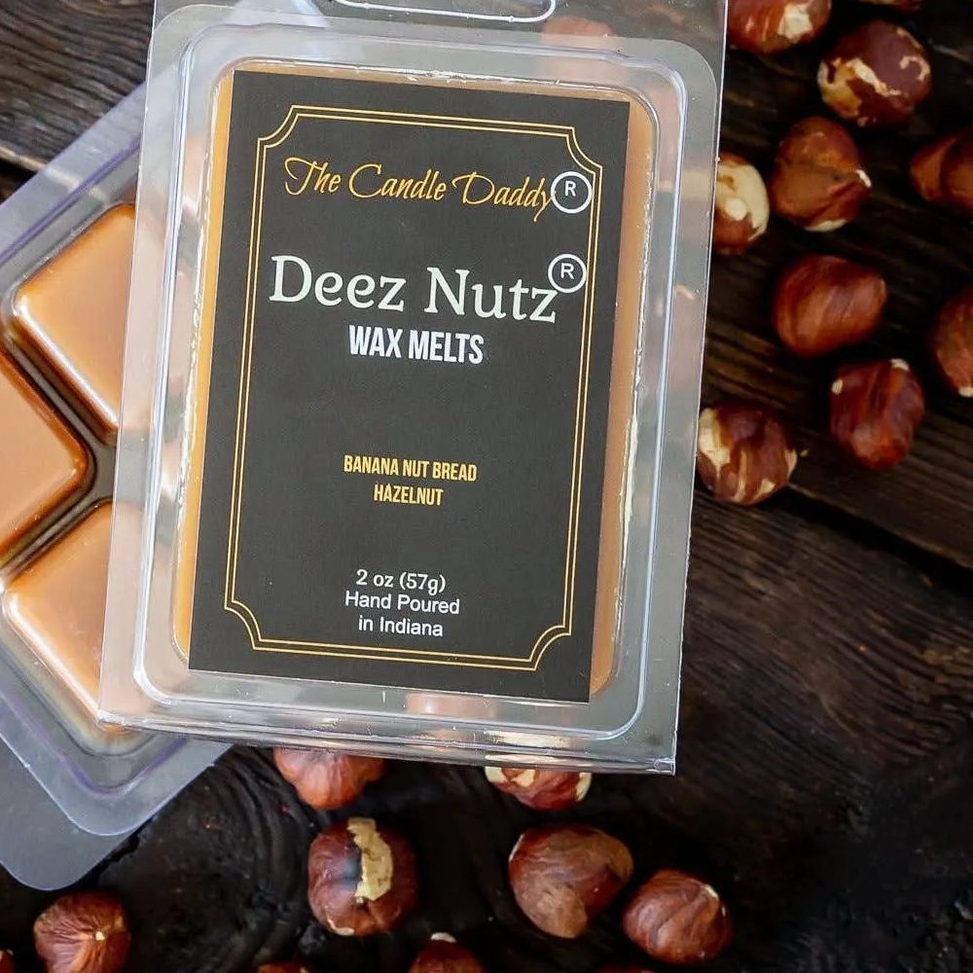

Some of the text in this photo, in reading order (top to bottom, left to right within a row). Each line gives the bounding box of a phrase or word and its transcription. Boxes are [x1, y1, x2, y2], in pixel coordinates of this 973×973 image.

[284, 157, 341, 196] The
[348, 163, 447, 202] Candle
[269, 254, 407, 313] Deez
[348, 324, 485, 365] WAX MELTS
[343, 454, 478, 482] BANANA NUT BREAD
[373, 483, 444, 506] HAZELNUT
[355, 569, 446, 596] 2 oz (57g)
[345, 590, 460, 615] Hand Poured
[358, 615, 444, 637] in Indiana
